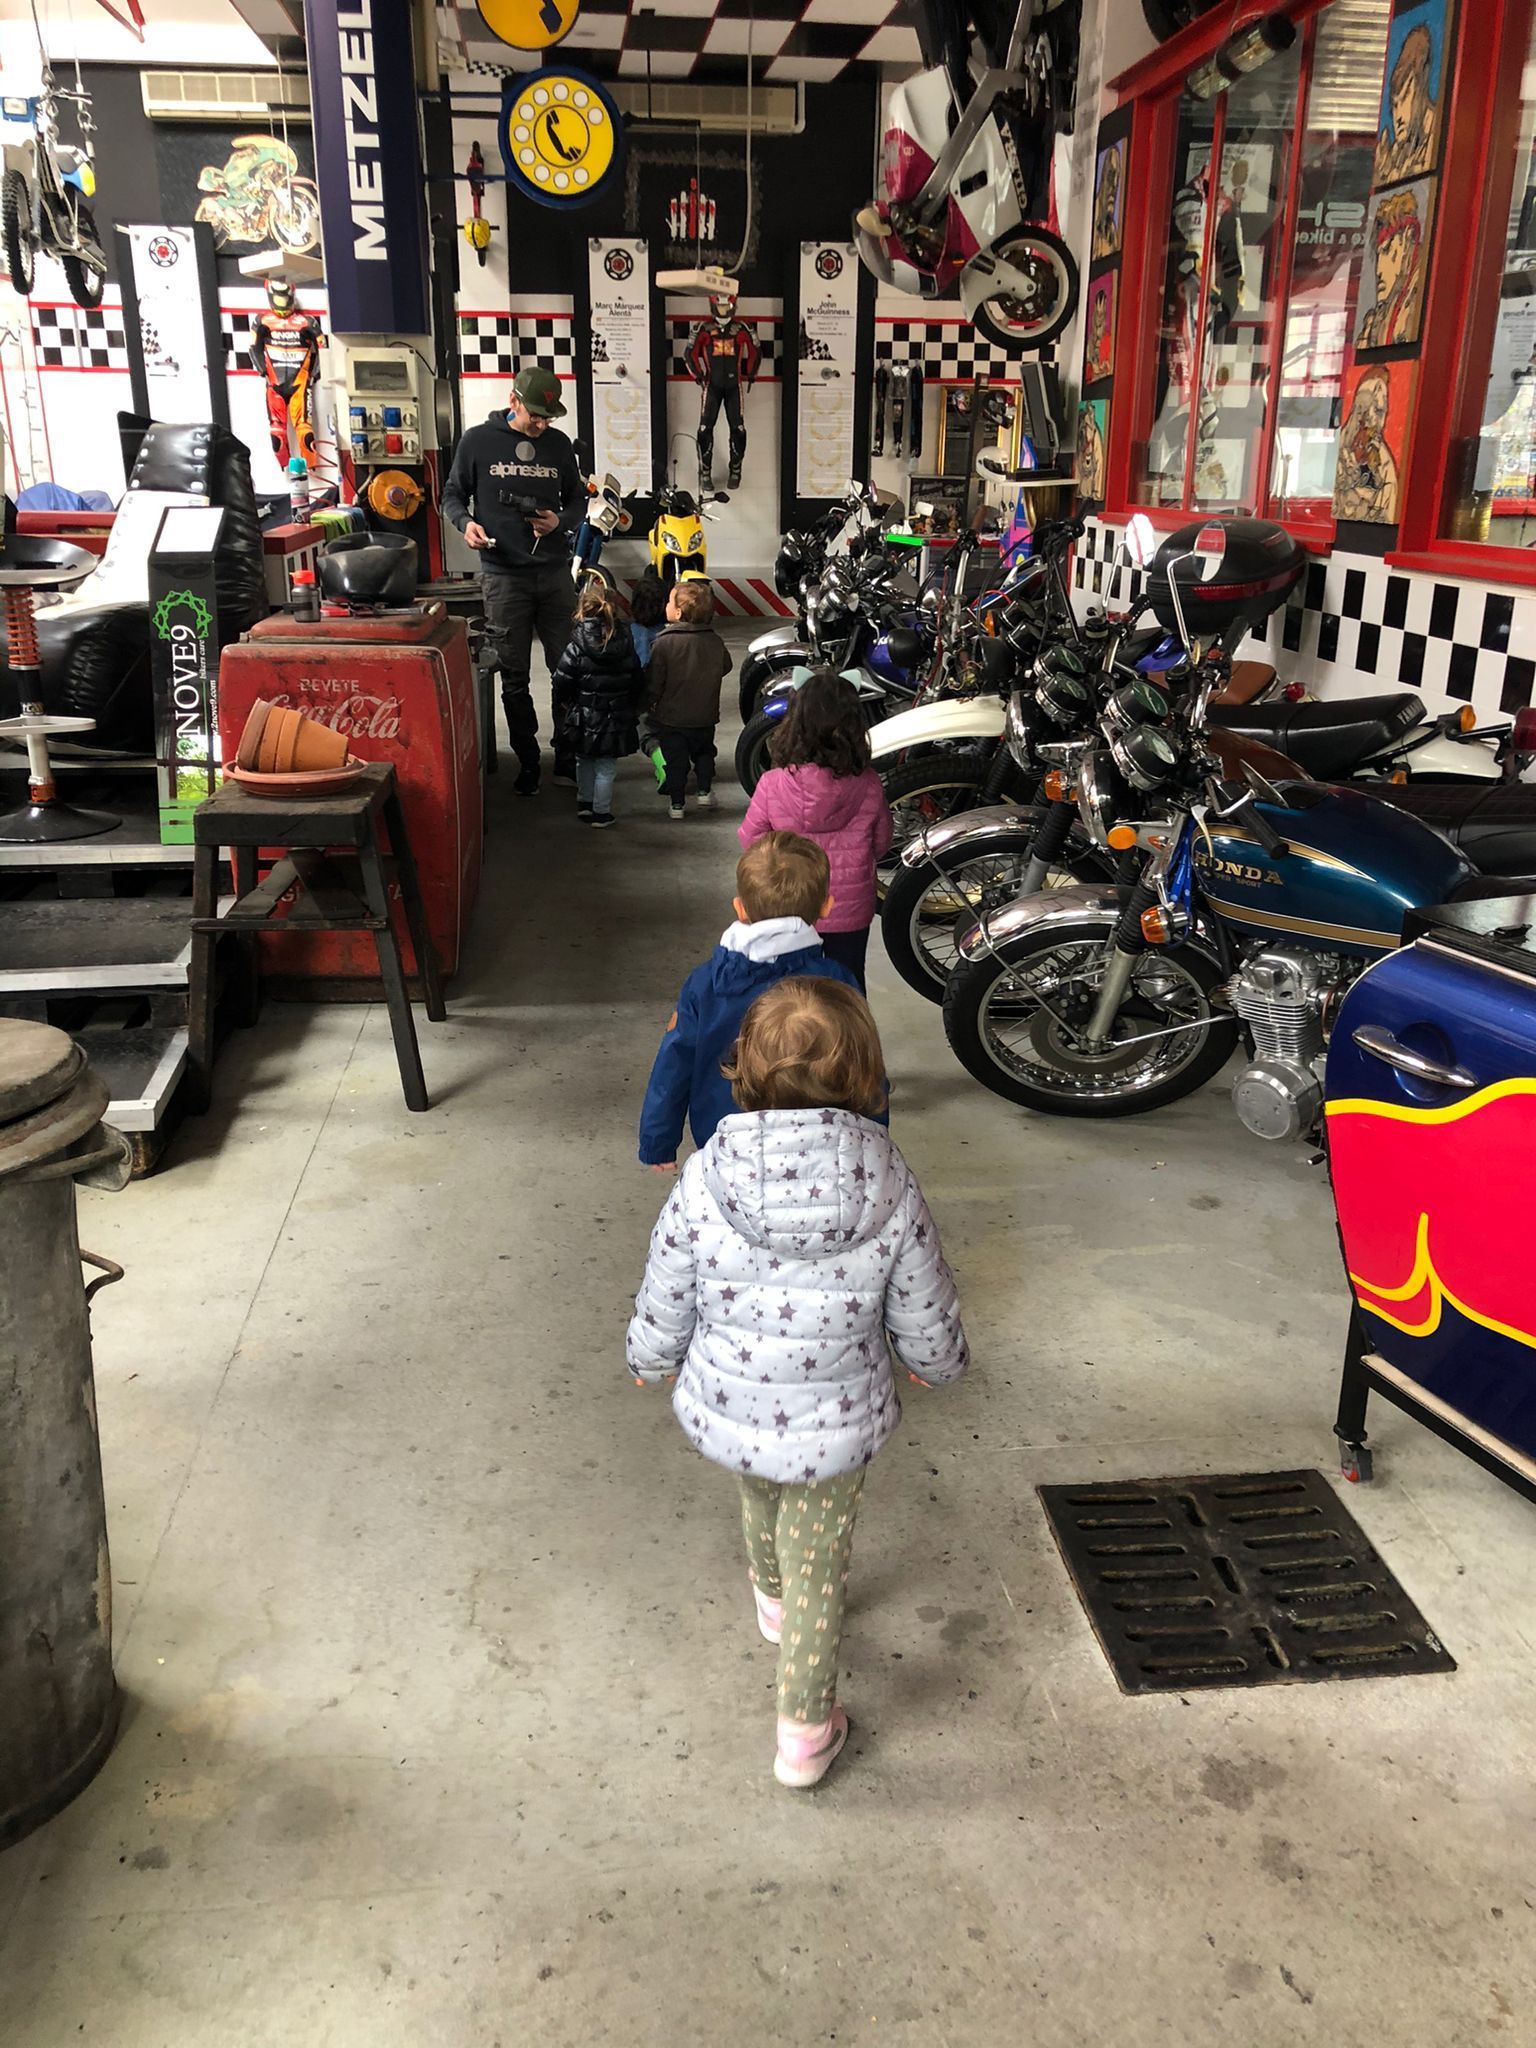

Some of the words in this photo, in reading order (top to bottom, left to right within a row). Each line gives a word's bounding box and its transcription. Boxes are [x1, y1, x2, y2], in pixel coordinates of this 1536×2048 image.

[595, 302, 613, 310] Marc
[820, 301, 837, 310] John
[807, 307, 850, 315] McGuinness
[489, 461, 559, 479] alpinestars
[298, 678, 360, 693] BEVETE
